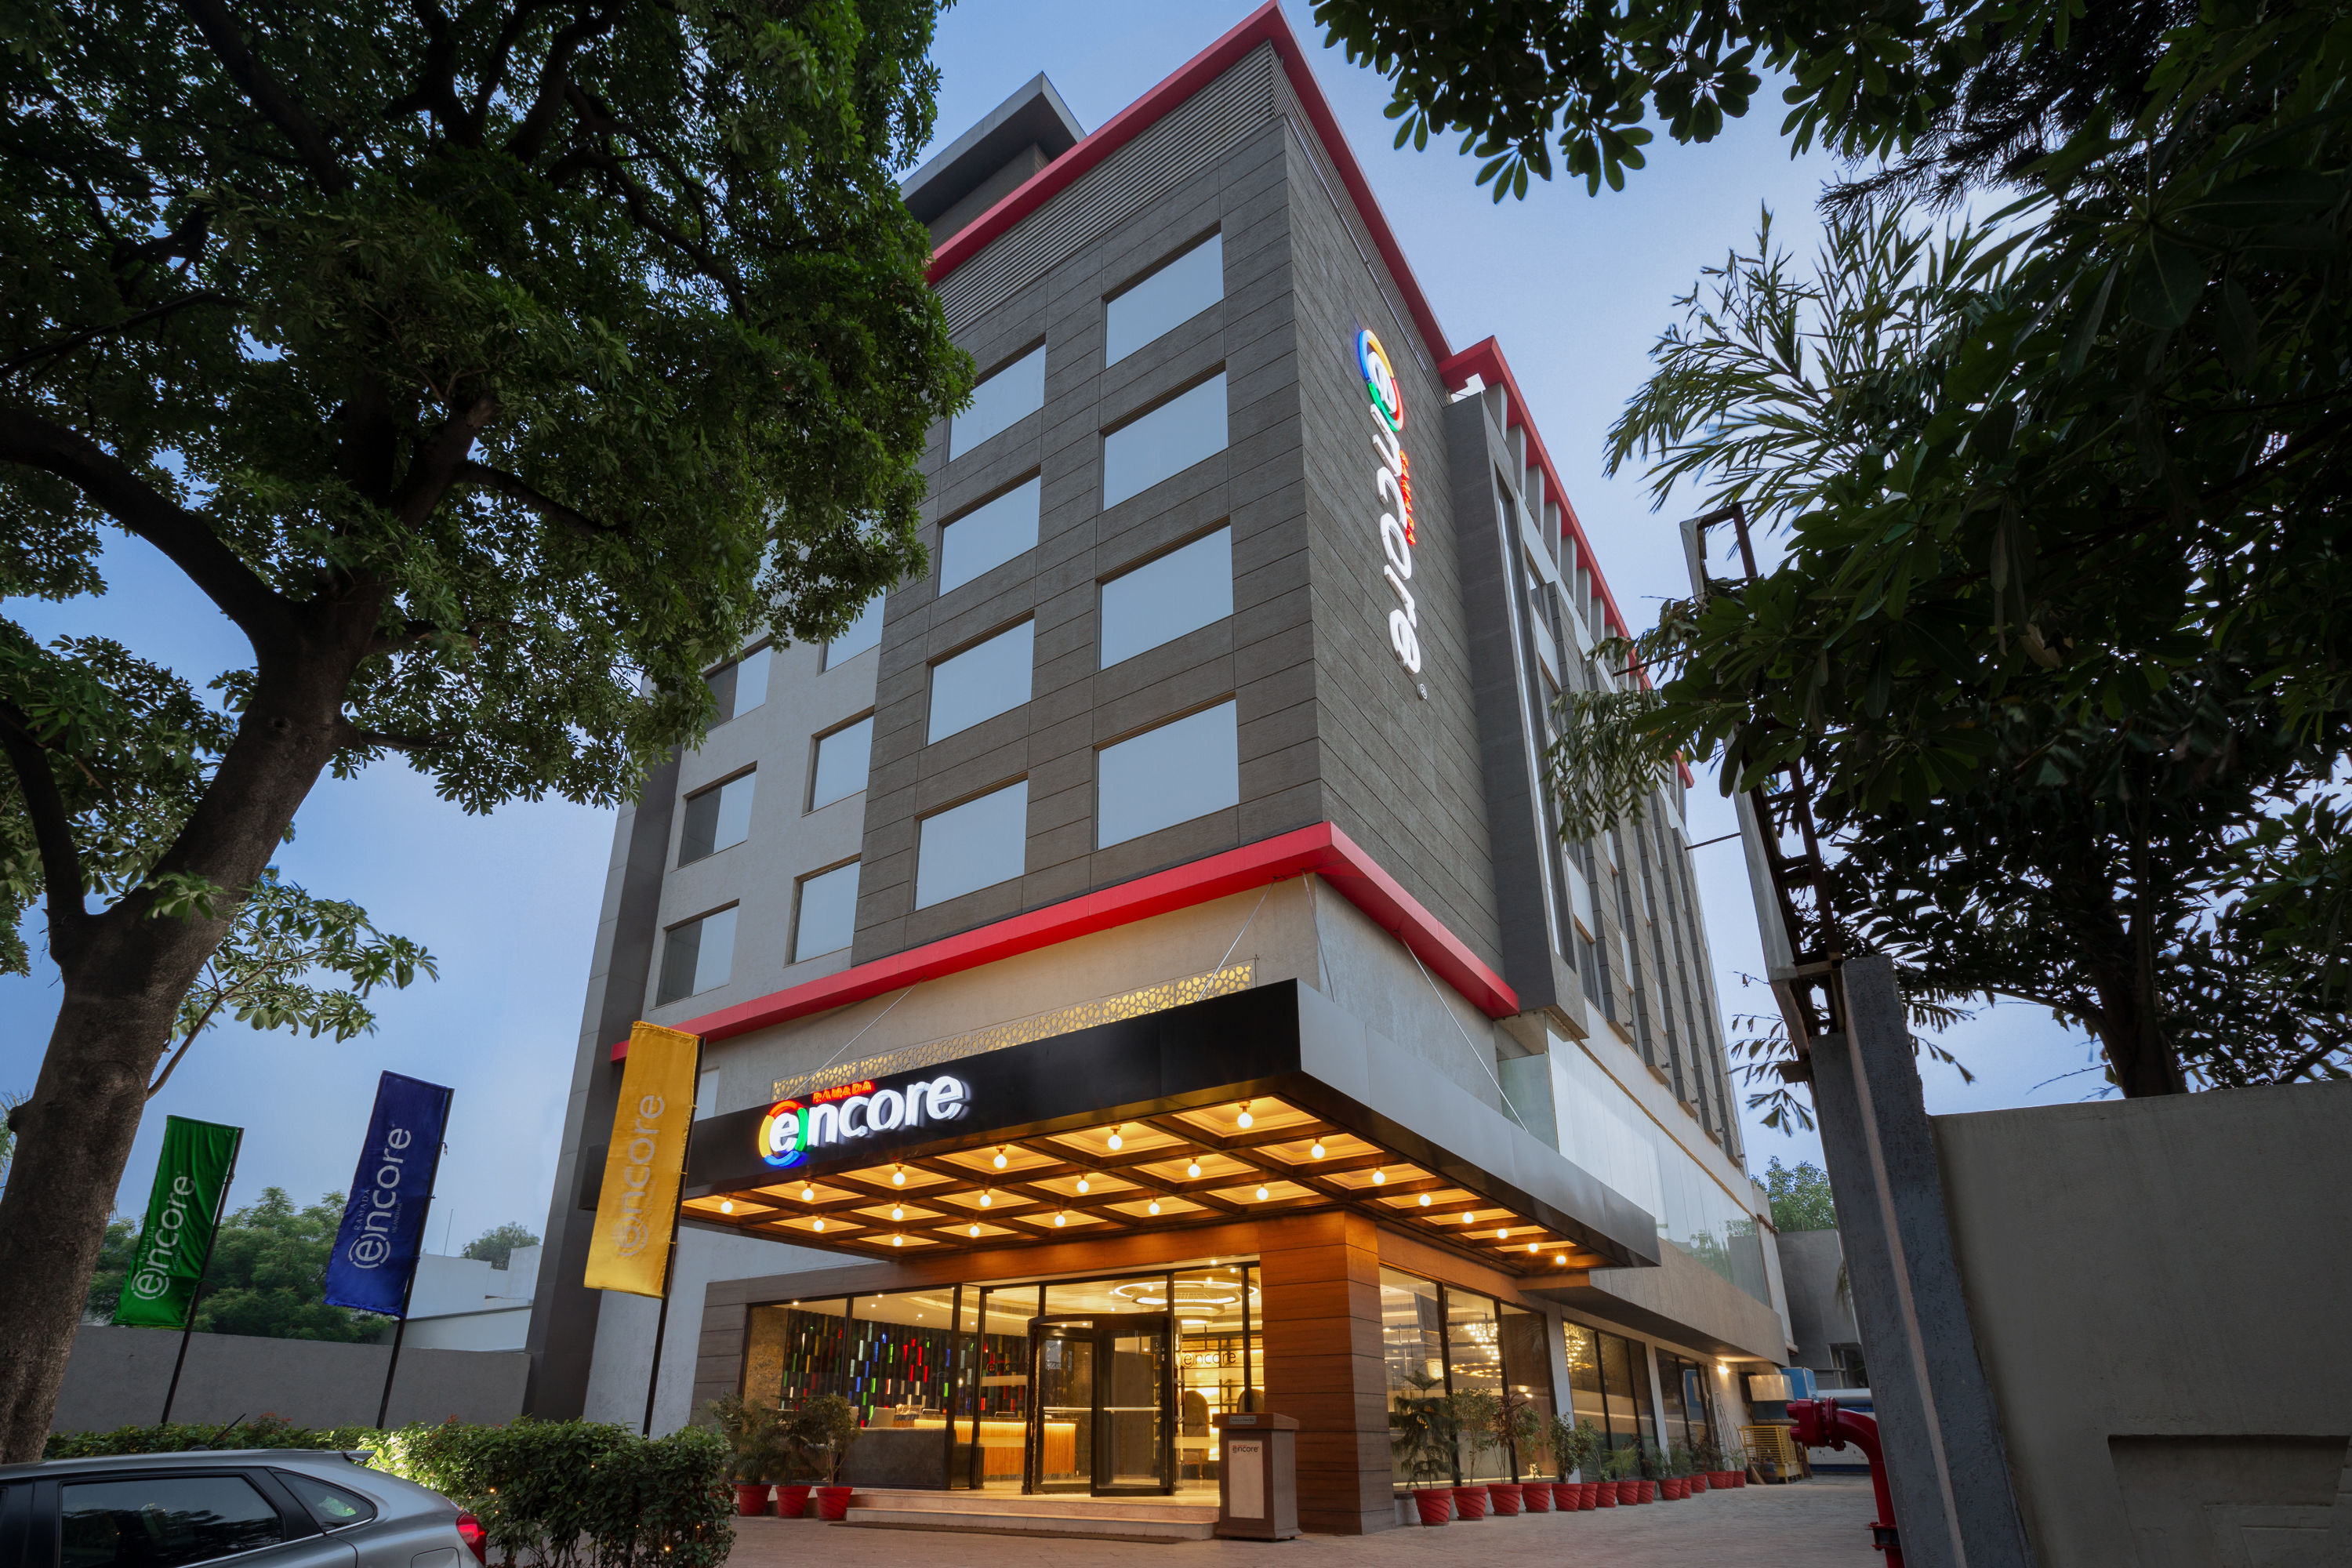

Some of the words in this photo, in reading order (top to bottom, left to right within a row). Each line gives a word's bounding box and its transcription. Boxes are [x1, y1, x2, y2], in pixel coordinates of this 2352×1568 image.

[1359, 329, 1421, 674] encore
[759, 1076, 964, 1167] encore
[813, 1080, 874, 1103] RAMADA
[348, 1127, 412, 1269] encore
[354, 1189, 371, 1232] RAMADA
[612, 1094, 665, 1257] encore
[131, 1175, 196, 1300] encore
[1181, 1352, 1236, 1368] encore
[1232, 1445, 1258, 1454] encore
